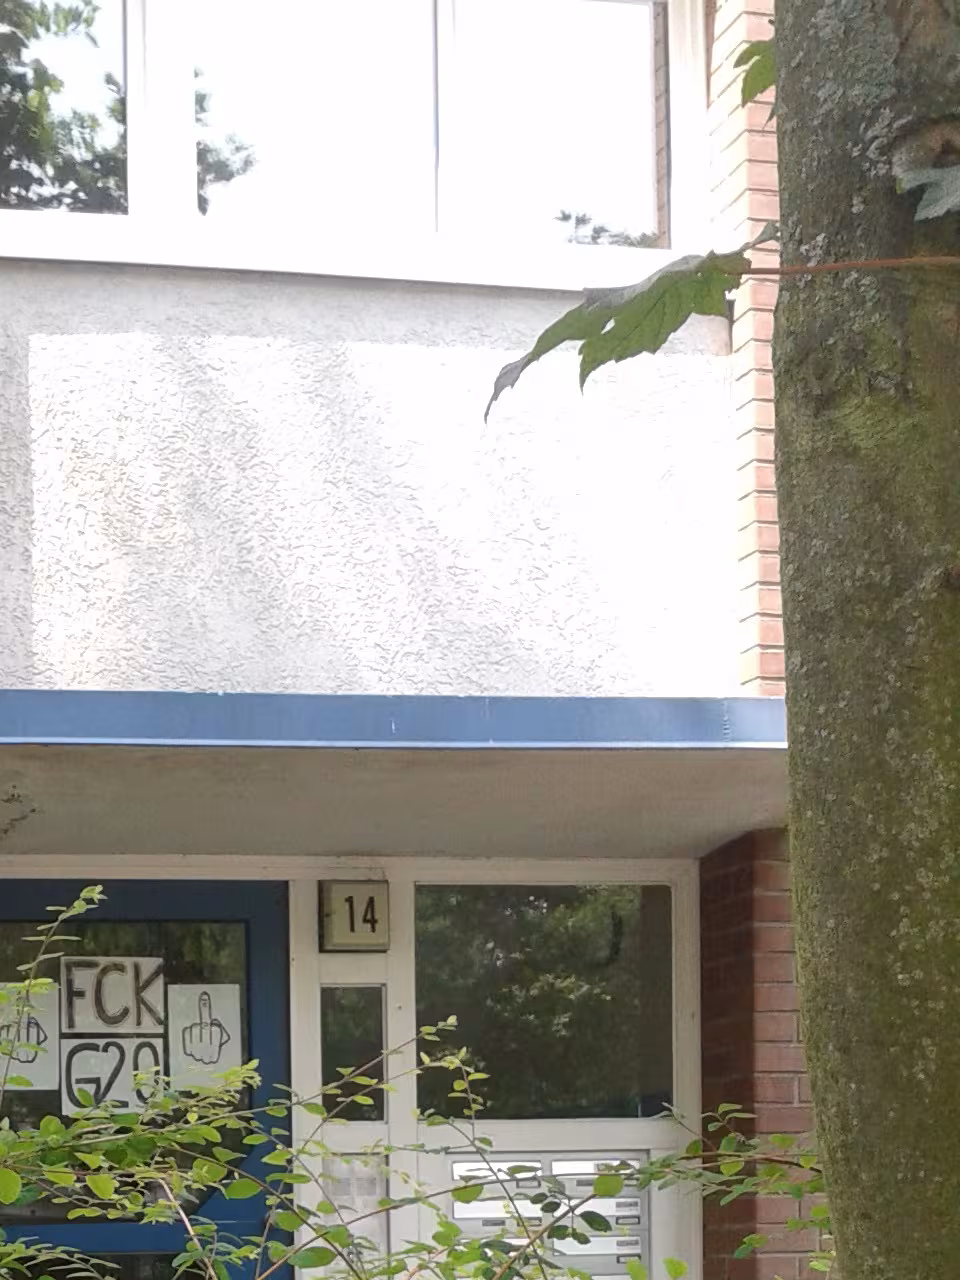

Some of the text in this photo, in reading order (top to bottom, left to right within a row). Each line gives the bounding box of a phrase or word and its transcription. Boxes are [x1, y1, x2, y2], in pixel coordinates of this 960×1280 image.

[344, 895, 379, 933] 14
[64, 958, 165, 1030] FCK
[65, 1041, 161, 1109] G20
